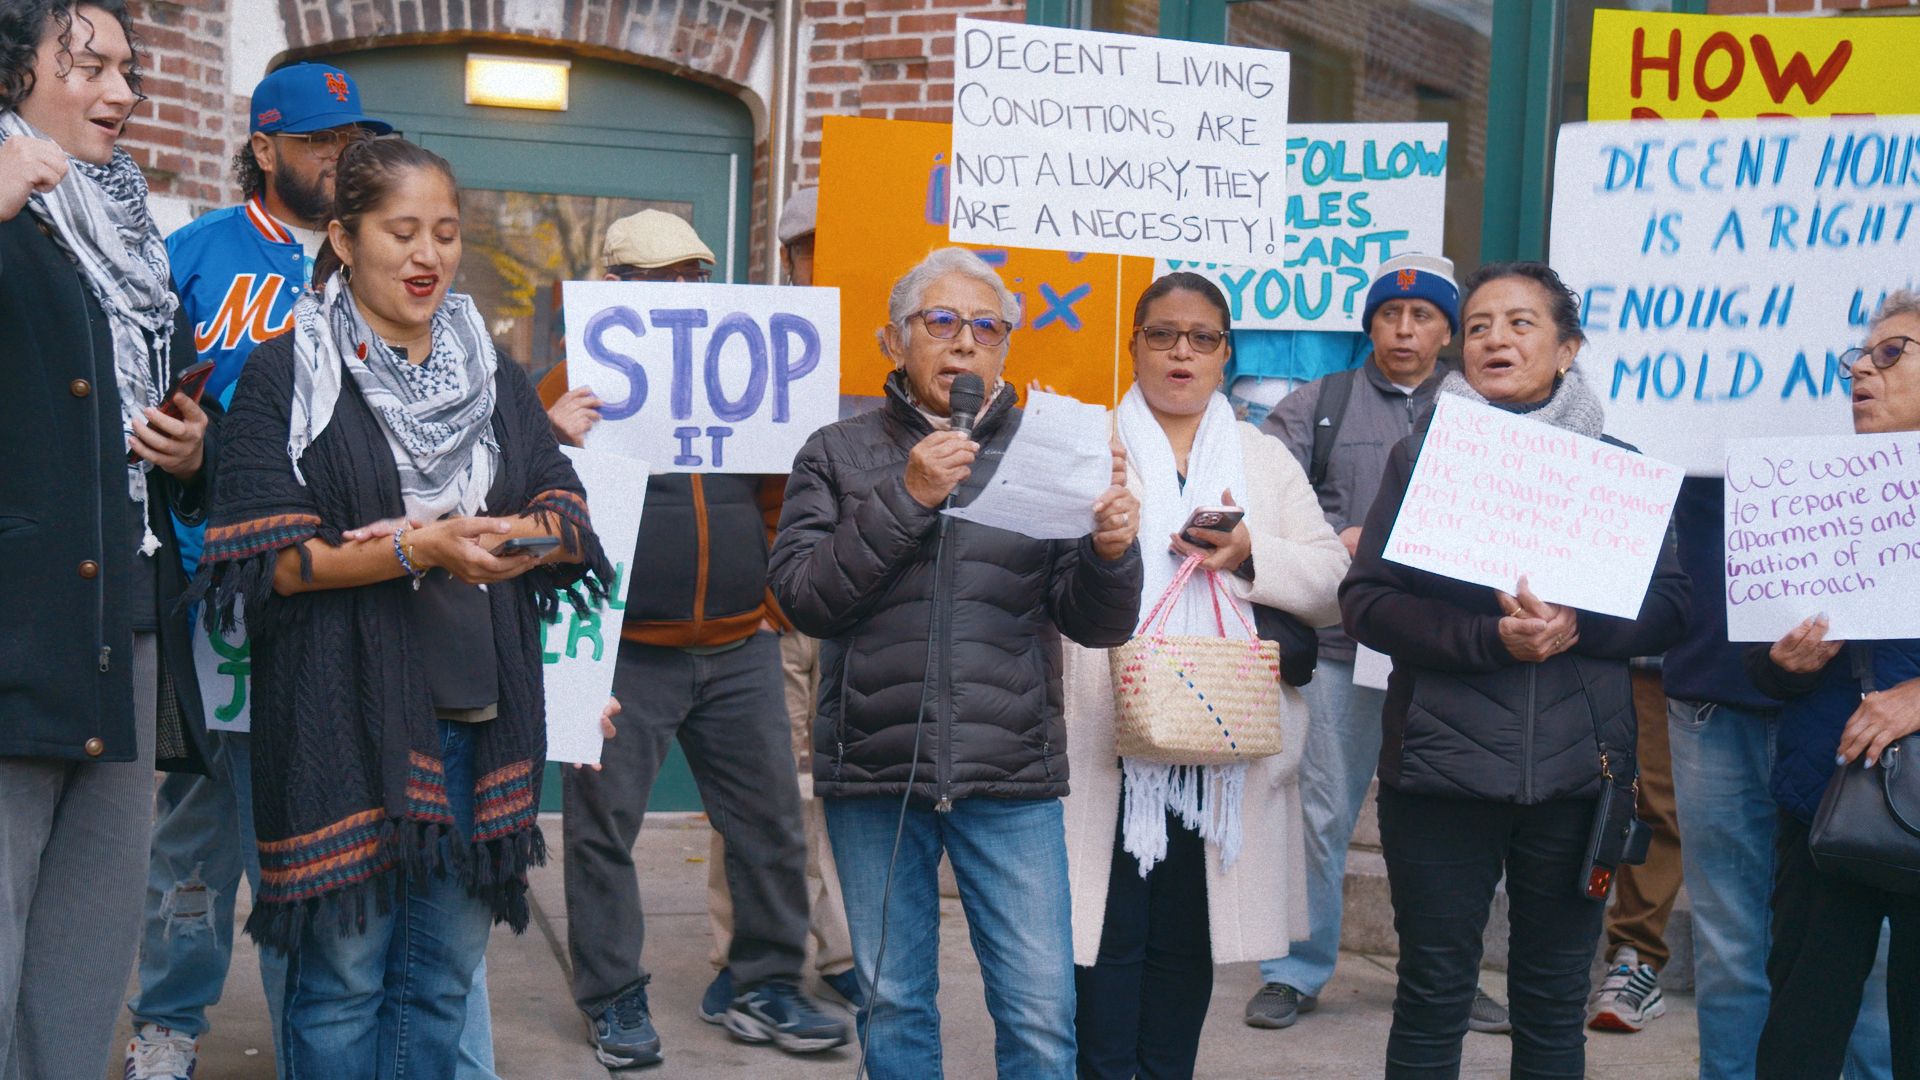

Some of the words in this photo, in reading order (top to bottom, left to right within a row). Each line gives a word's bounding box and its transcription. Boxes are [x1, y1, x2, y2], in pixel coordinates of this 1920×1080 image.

[963, 28, 1136, 75] DECENT
[1156, 51, 1274, 98] LIVING
[1630, 27, 1853, 105] HOW
[958, 82, 1174, 138] CONDITIONS
[1197, 111, 1260, 145] ARE
[956, 152, 1029, 187] NOT
[1035, 152, 1060, 186] A
[1069, 152, 1190, 201] LUXURY,
[1196, 165, 1269, 208] THEY
[1597, 136, 1798, 192] DECENT
[952, 196, 1017, 231] ARE
[1035, 204, 1061, 237] A
[1072, 209, 1276, 255] NECESSITY!
[1641, 207, 1683, 255] IS
[1711, 206, 1746, 251] A
[1764, 200, 1920, 248] RIGHT
[1219, 267, 1370, 320] YOU?
[1580, 282, 1795, 332] ENOUGH
[583, 305, 821, 423] STOP
[1610, 349, 1763, 402] MOLD
[1780, 349, 1852, 400] AN
[674, 426, 734, 467] IT
[1438, 403, 1492, 436] We
[1500, 422, 1578, 460] want
[1726, 455, 1797, 493] We
[1809, 442, 1904, 480] want
[1730, 497, 1759, 526] to
[1772, 486, 1871, 519] reparie
[1881, 479, 1920, 503] ou
[1871, 504, 1917, 533] and
[1834, 539, 1862, 567] of
[1728, 573, 1875, 605] Cockroach
